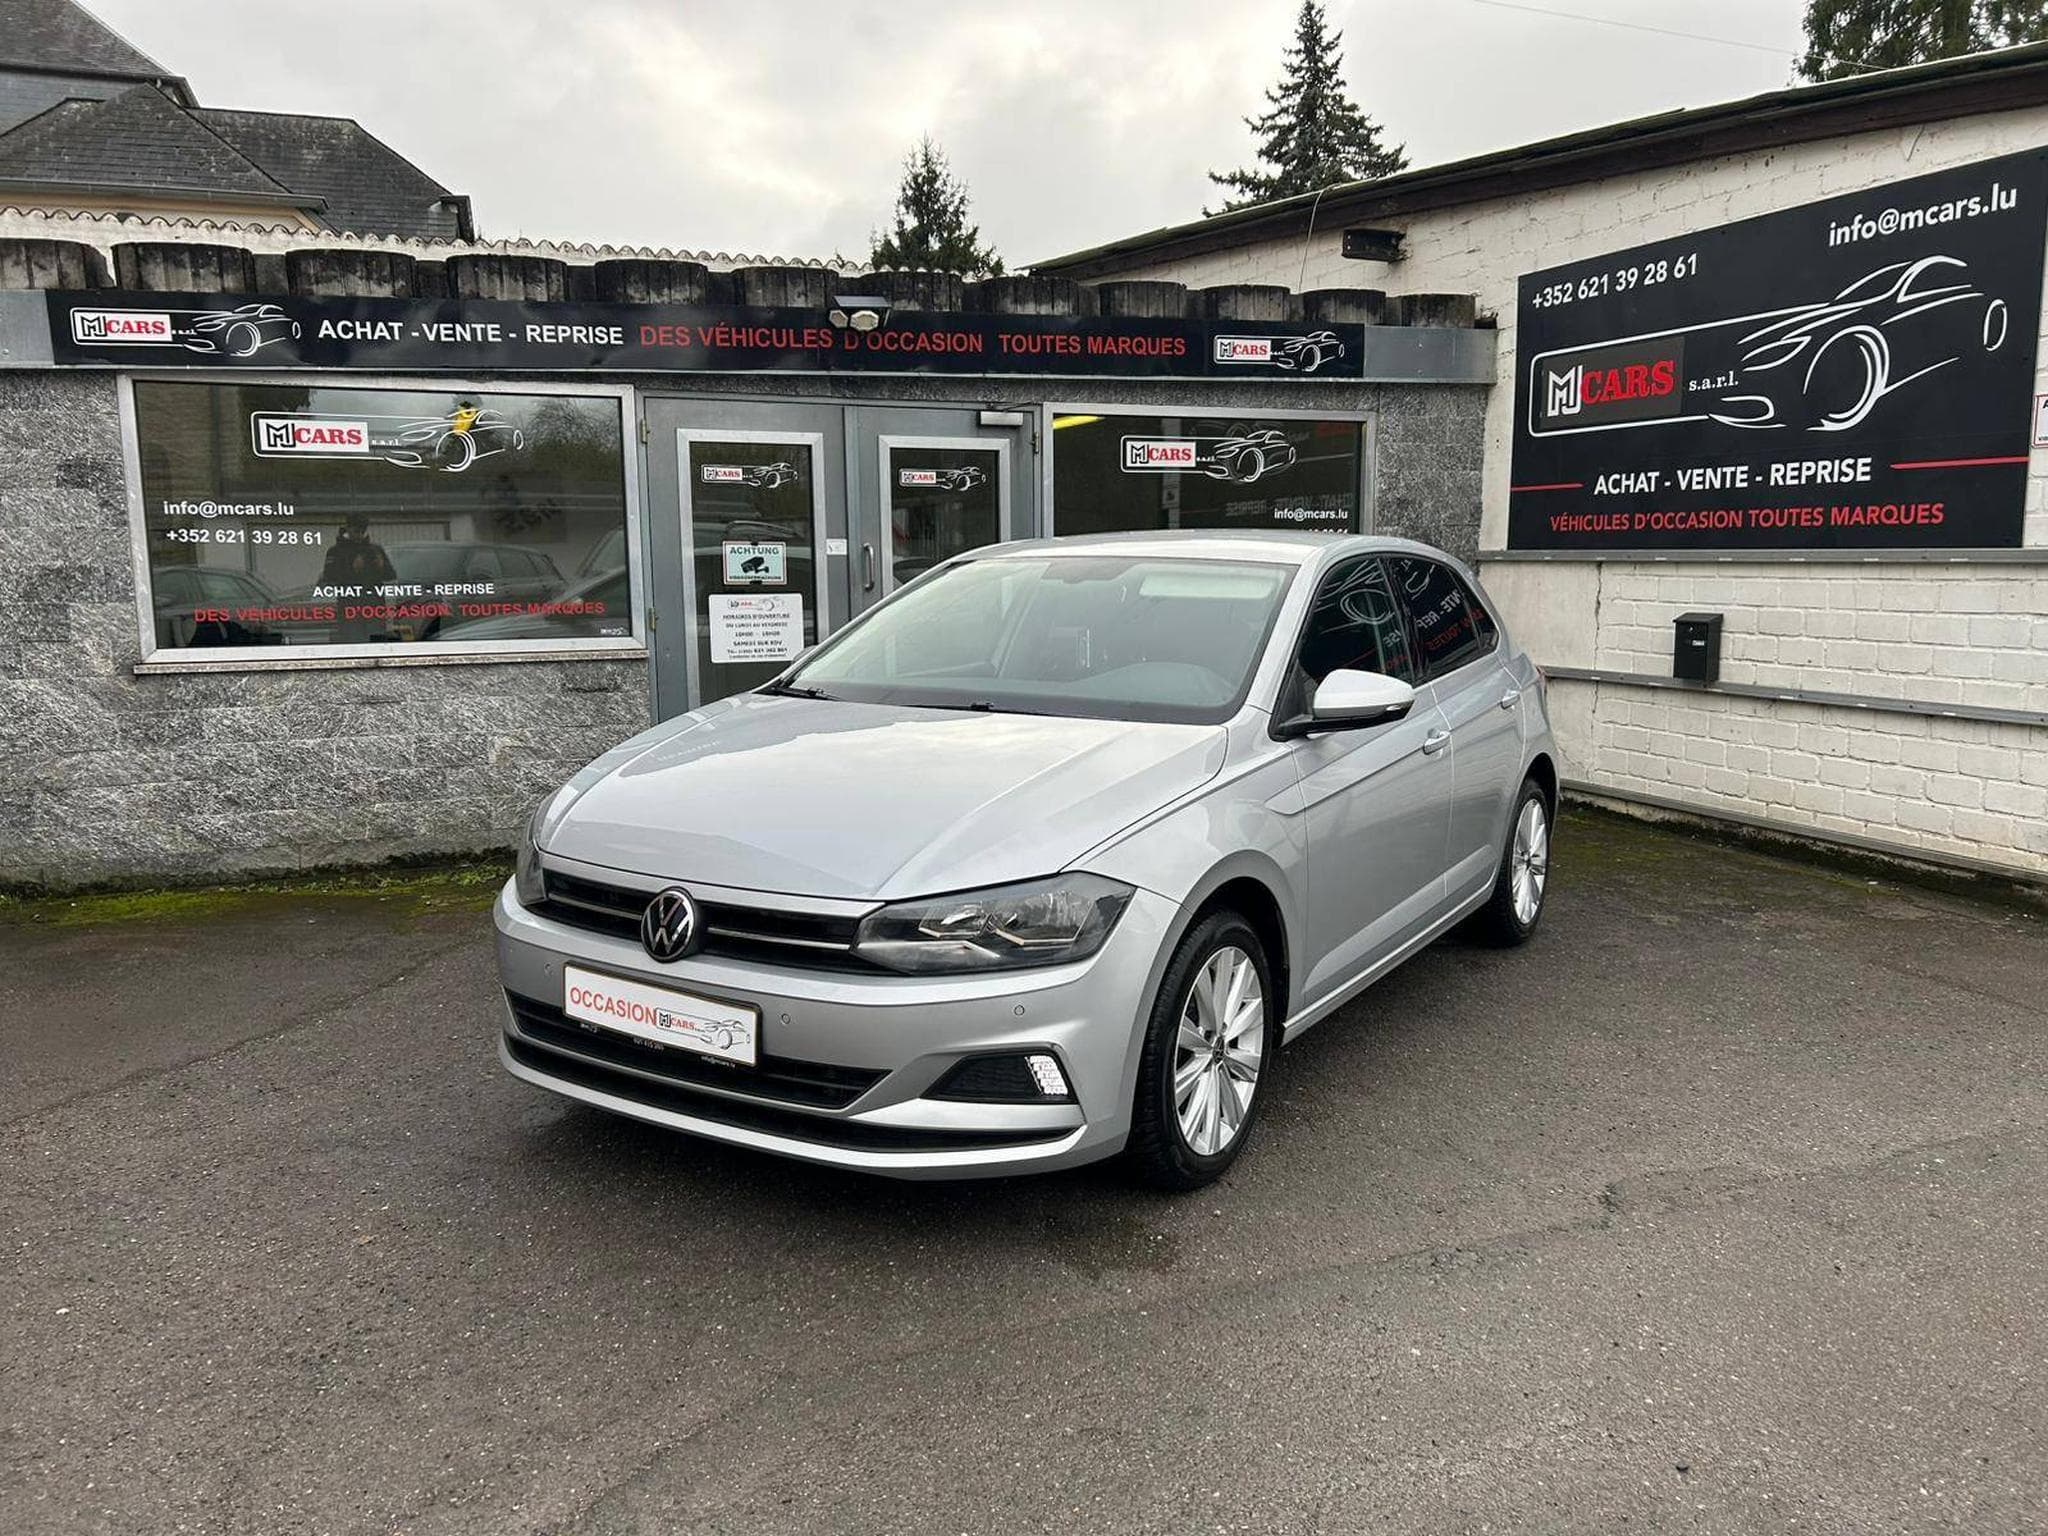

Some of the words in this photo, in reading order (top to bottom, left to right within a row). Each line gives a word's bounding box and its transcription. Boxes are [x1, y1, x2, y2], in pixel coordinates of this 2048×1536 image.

[1828, 182, 2018, 247] info@mcars.lu
[1532, 282, 1573, 308] +352
[1578, 273, 1609, 300] 621
[1615, 267, 1639, 292] 39
[1644, 260, 1668, 285] 28
[1673, 253, 1697, 279] 61
[318, 319, 403, 341] ACHAT
[526, 325, 624, 345] REPRISE
[640, 325, 690, 347] DES
[699, 321, 833, 348] VÉHICULES
[999, 333, 1081, 353] TOUTES
[1087, 335, 1186, 356] MARQUES
[1689, 371, 1739, 391] s.a.r.l.
[1593, 471, 1660, 495] ACHAT
[1677, 465, 1749, 491] VENTE
[1769, 457, 1872, 487] REPRISE
[163, 500, 294, 519] info@mcars.lu
[1274, 507, 1348, 522] info@mcars.lu
[1550, 511, 1630, 532] VÉHICULES
[1748, 507, 1825, 528] TOUTES
[1830, 503, 1945, 526] MARQUES
[166, 528, 210, 543] +352
[215, 529, 245, 544] 621
[252, 530, 273, 544] 39
[278, 531, 298, 545] 28
[303, 531, 322, 545] 61
[729, 546, 780, 556] ACHTUNG
[312, 585, 363, 598] ACHAT
[375, 585, 422, 597] VENTE
[435, 583, 495, 595] REPRISE
[194, 607, 231, 622] DES
[459, 603, 522, 617] TOUTES
[528, 602, 605, 616] MARQUES
[570, 986, 656, 1026] OCCASION
